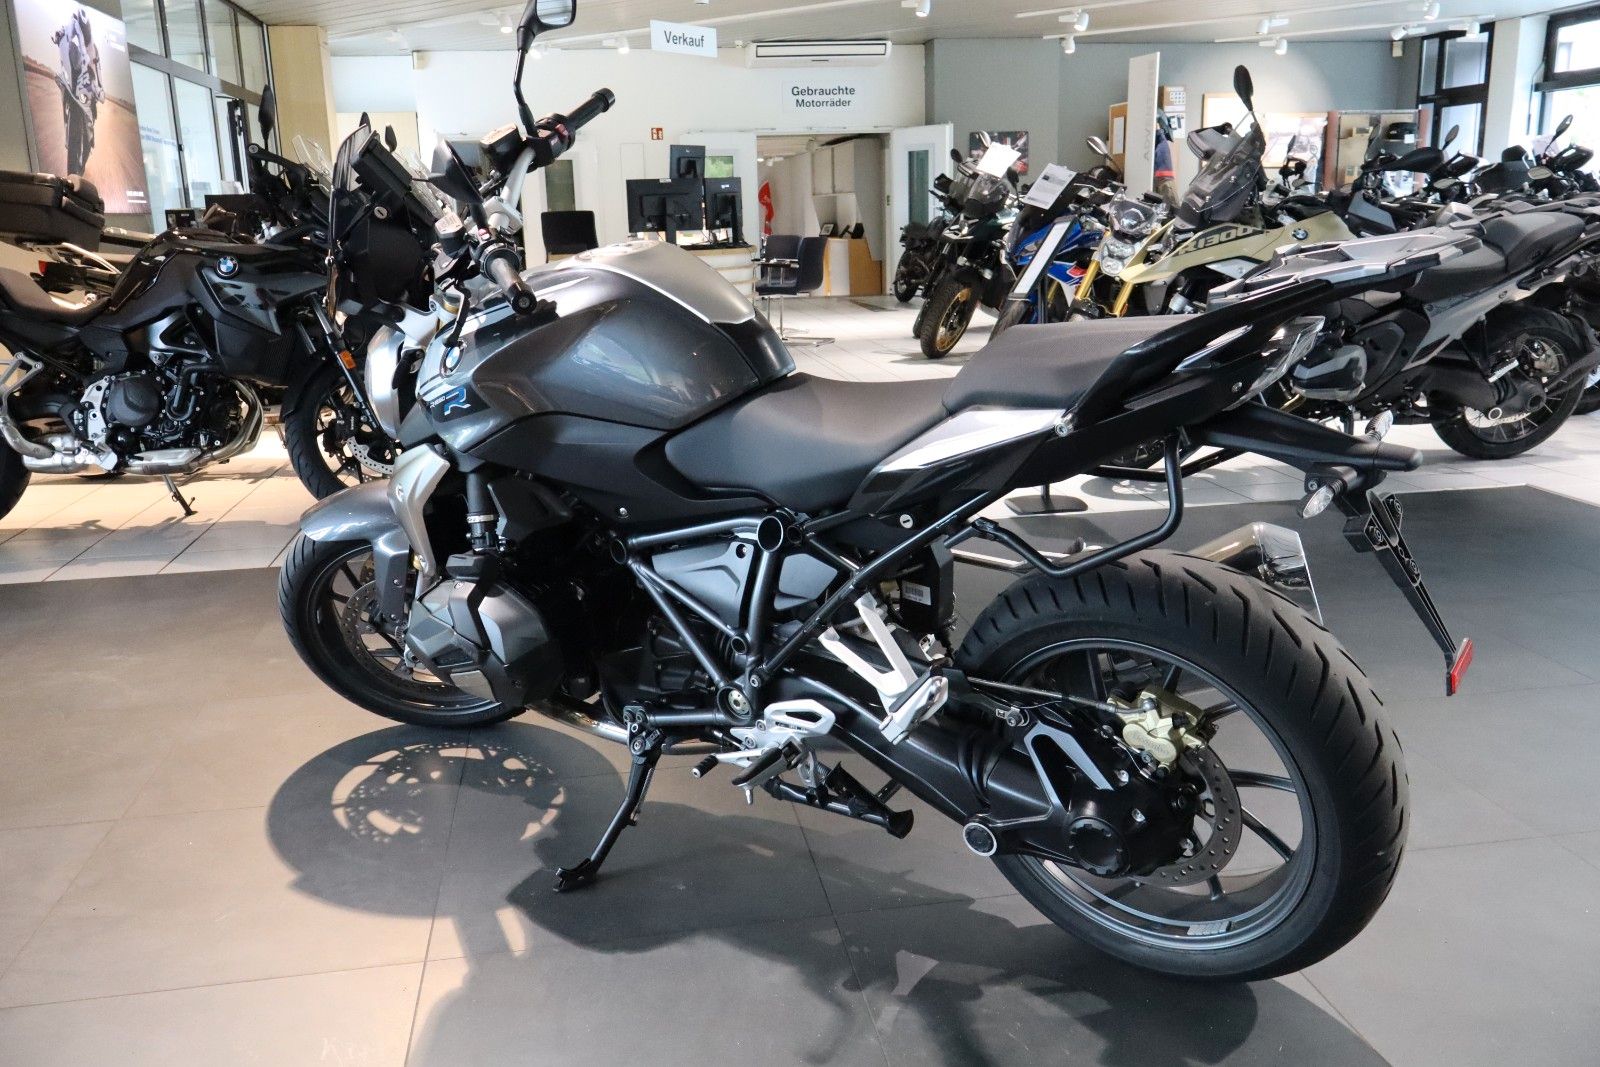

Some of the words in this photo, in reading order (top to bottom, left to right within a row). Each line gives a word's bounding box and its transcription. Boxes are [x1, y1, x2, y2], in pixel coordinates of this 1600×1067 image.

[664, 30, 705, 47] Verkauf
[791, 86, 856, 96] Gebrauchte
[795, 98, 851, 107] Motorräder
